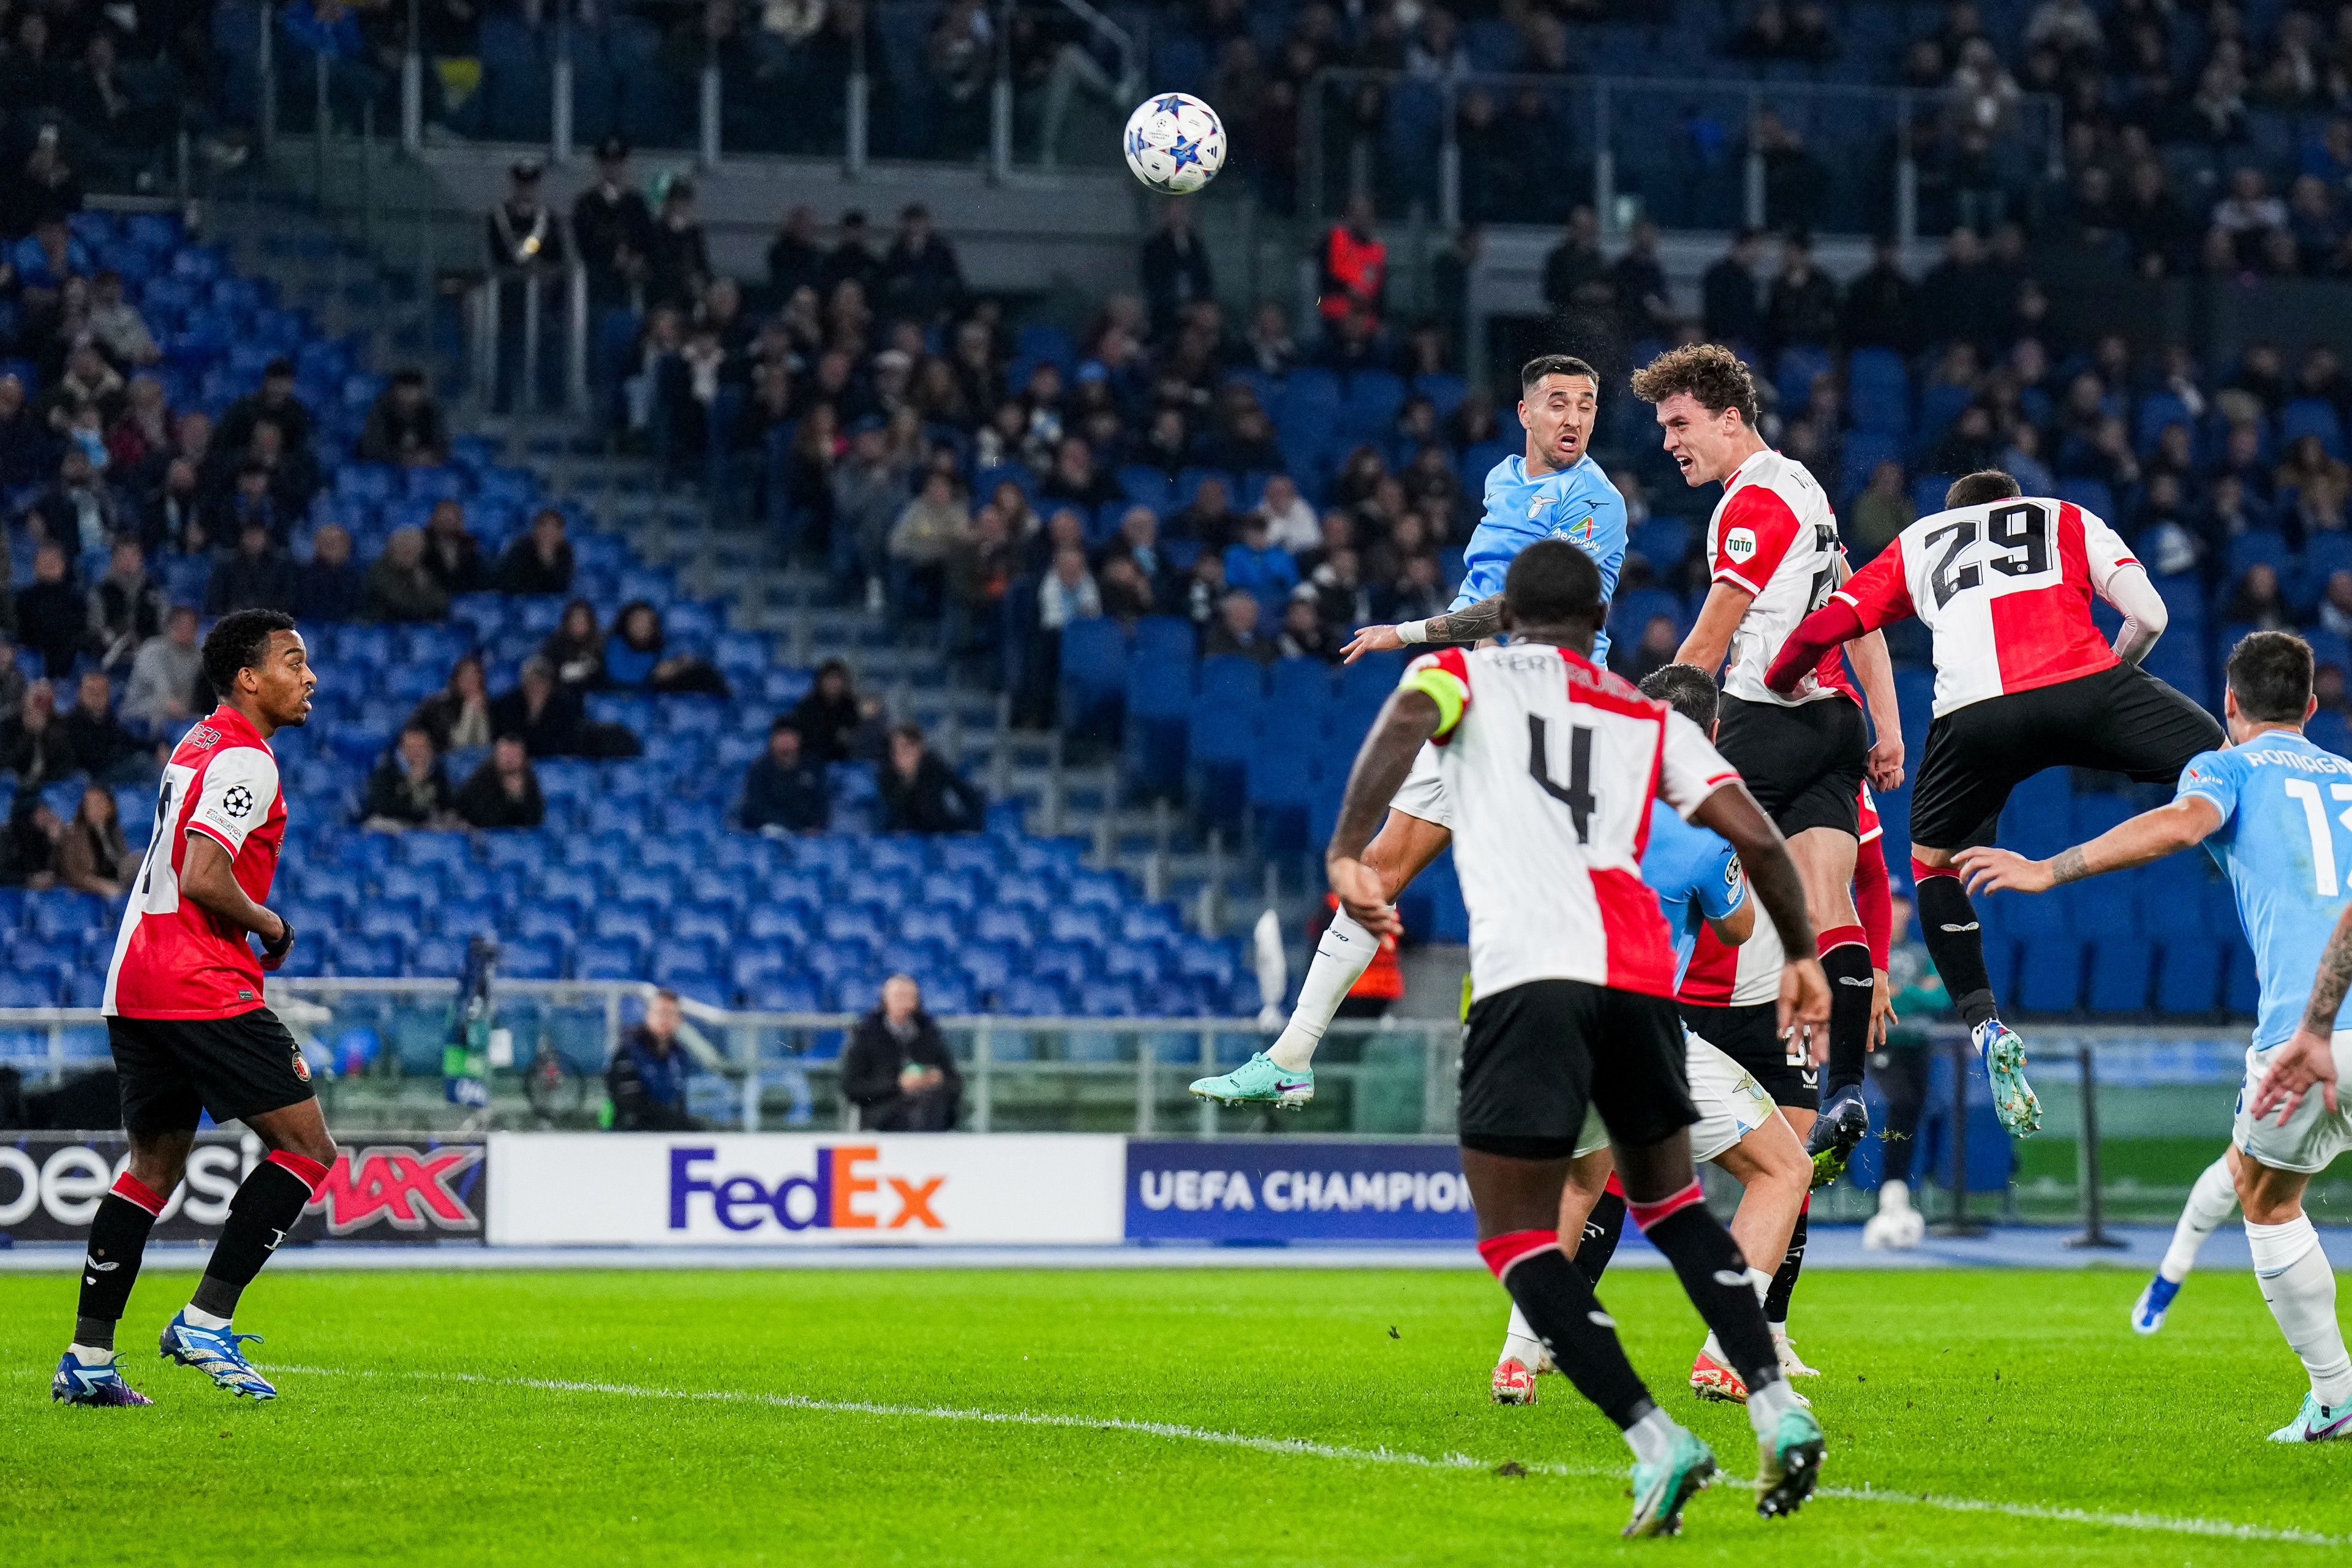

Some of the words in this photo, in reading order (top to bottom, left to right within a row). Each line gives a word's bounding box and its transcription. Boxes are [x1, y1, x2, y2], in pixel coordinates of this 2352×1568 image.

[1728, 539, 1752, 552] TOTO
[1925, 502, 2053, 611] 29
[1529, 710, 1596, 845] 4
[206, 810, 243, 839] FOUNDATION
[1329, 926, 1349, 942] ZIO
[306, 1146, 485, 1235] MAX
[669, 1147, 946, 1232] FedEx
[1139, 1170, 1256, 1212] UEFA
